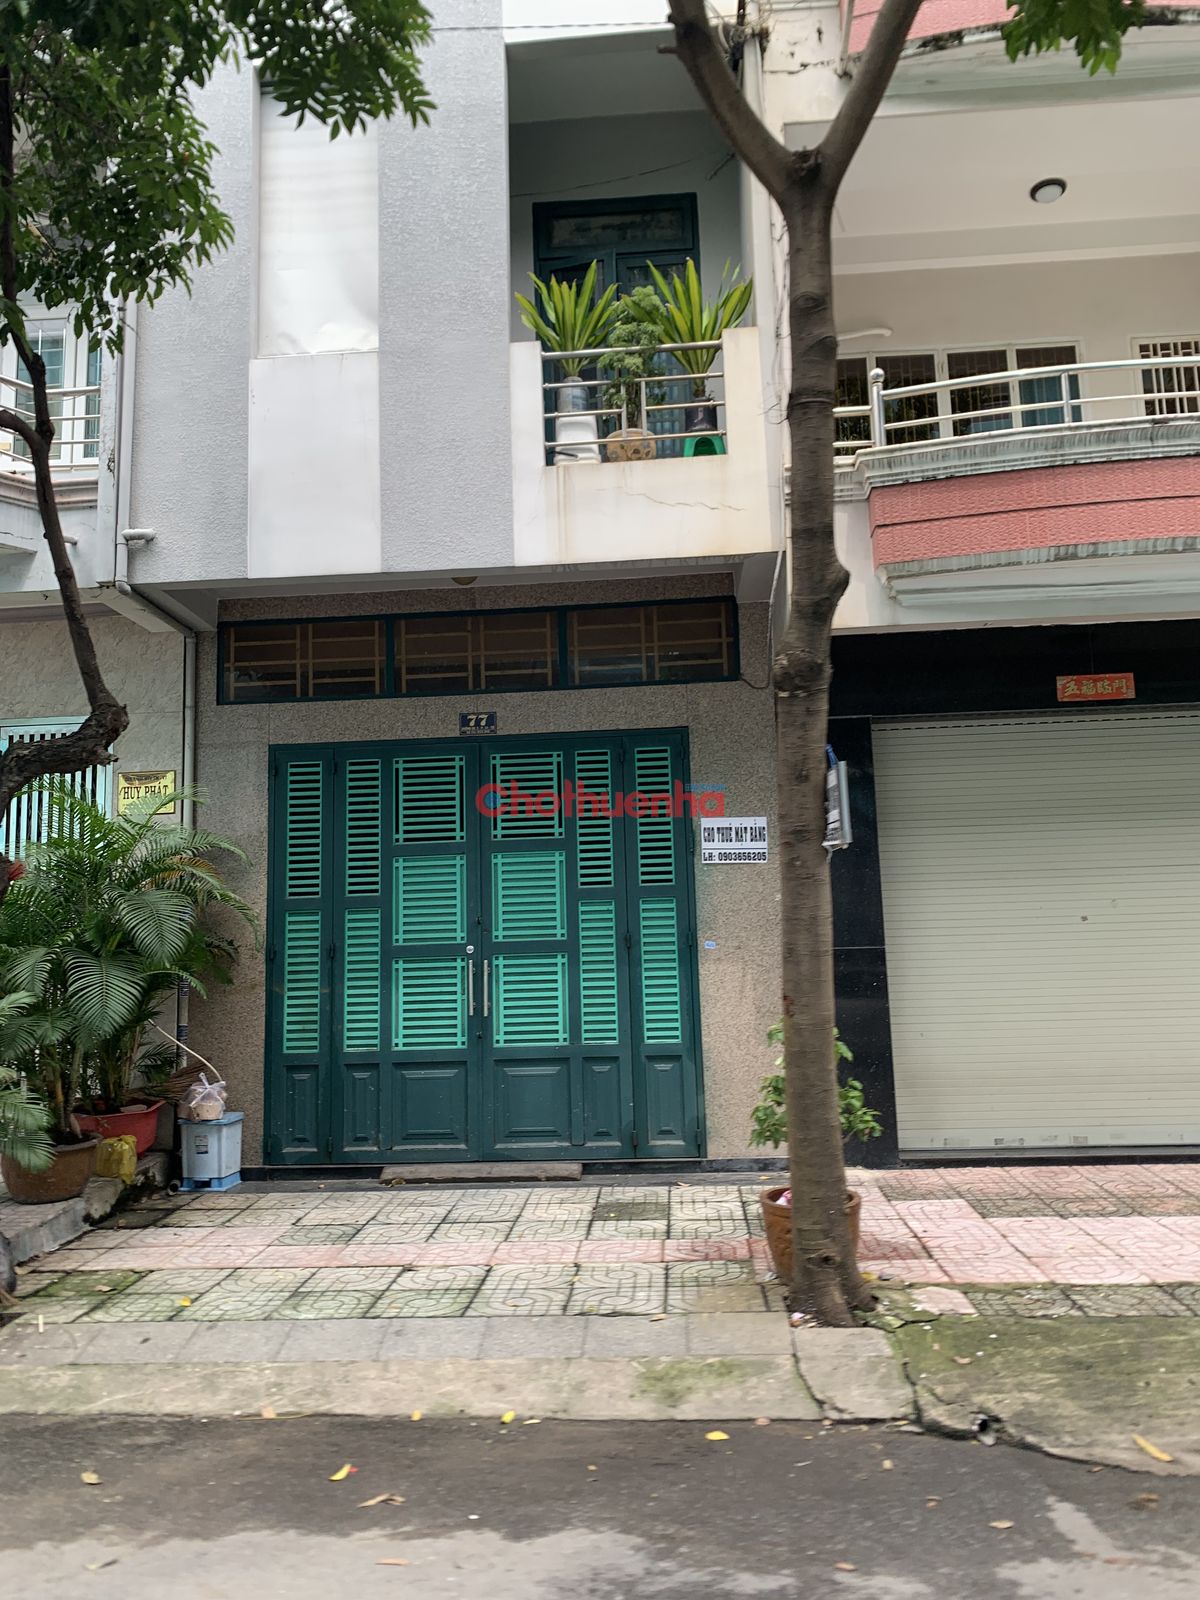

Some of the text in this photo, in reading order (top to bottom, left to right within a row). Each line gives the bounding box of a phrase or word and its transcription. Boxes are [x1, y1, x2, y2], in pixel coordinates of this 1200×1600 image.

[467, 714, 488, 727] 77
[123, 786, 141, 799] HUY
[703, 826, 715, 843] CHO
[703, 851, 767, 861] LH: 0903656205
